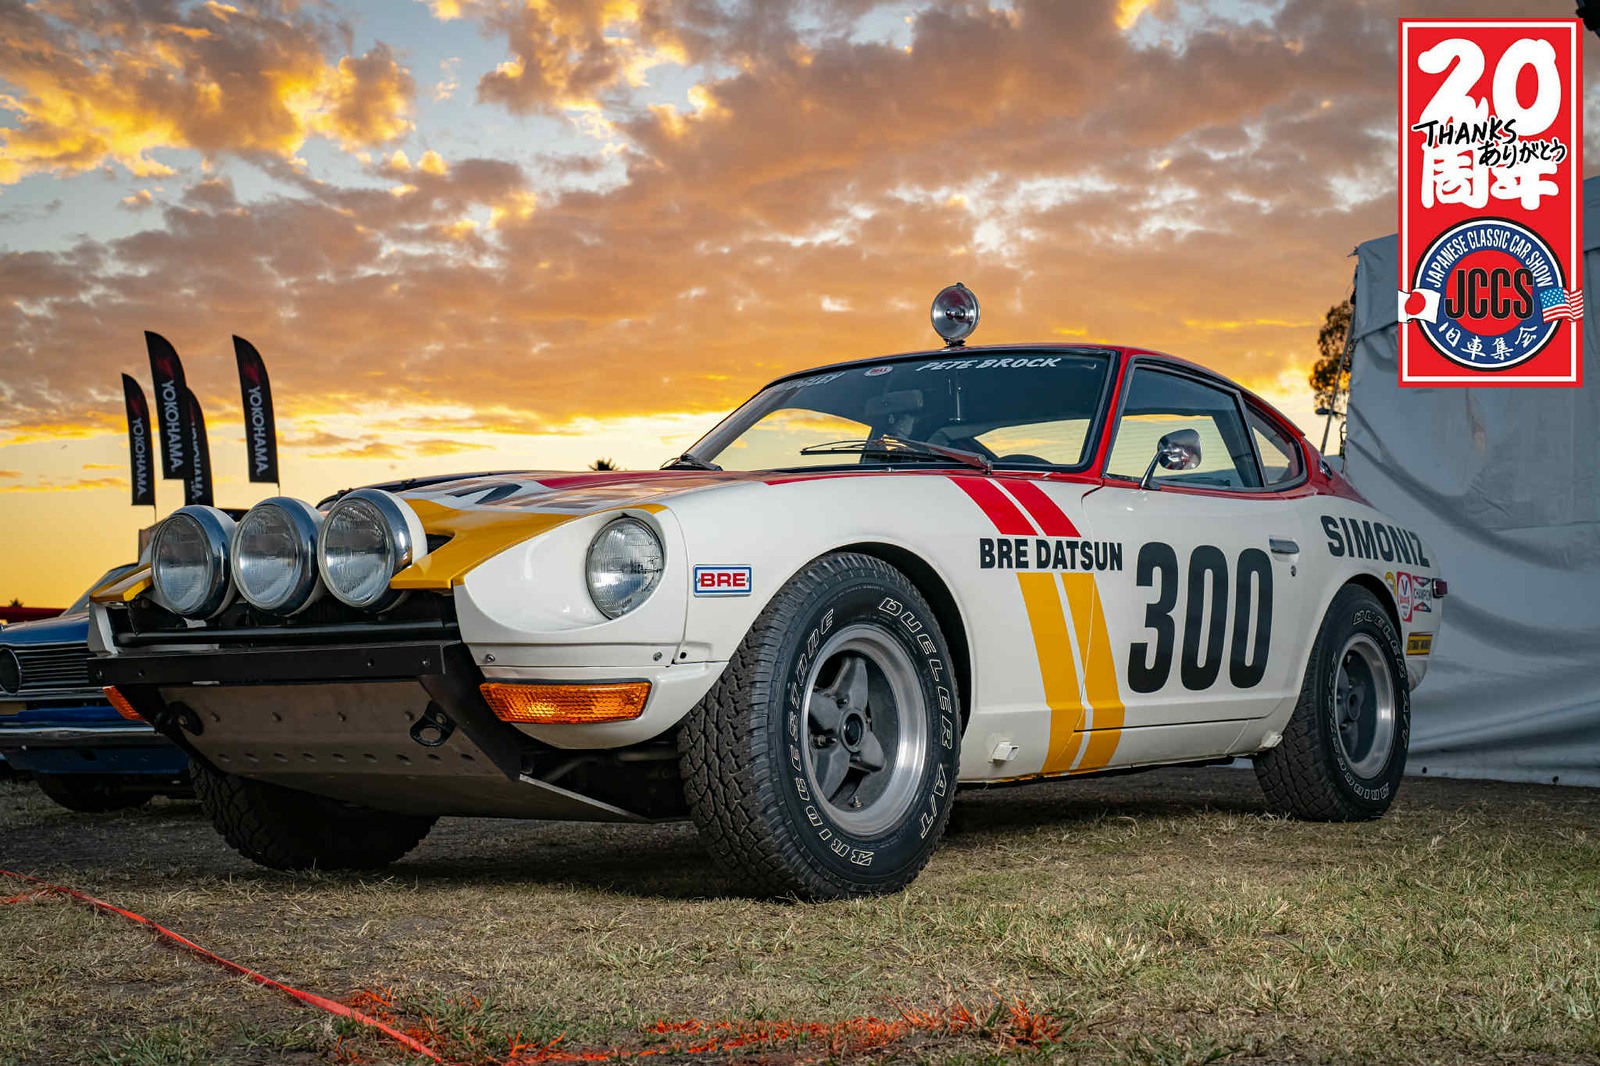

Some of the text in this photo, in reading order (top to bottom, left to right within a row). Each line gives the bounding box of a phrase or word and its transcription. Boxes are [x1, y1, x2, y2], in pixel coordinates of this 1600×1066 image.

[915, 358, 1061, 371] PETE BROCK
[132, 417, 148, 496] YOKOHAMA
[161, 380, 184, 471] YOKOHAMA
[248, 386, 269, 475] YOKOHAMA
[700, 572, 746, 587] BRE
[979, 538, 1123, 571] BRE DATSUN
[1320, 515, 1431, 568] SIMONIZ
[1127, 541, 1273, 693] 300
[878, 597, 953, 750] DUELER
